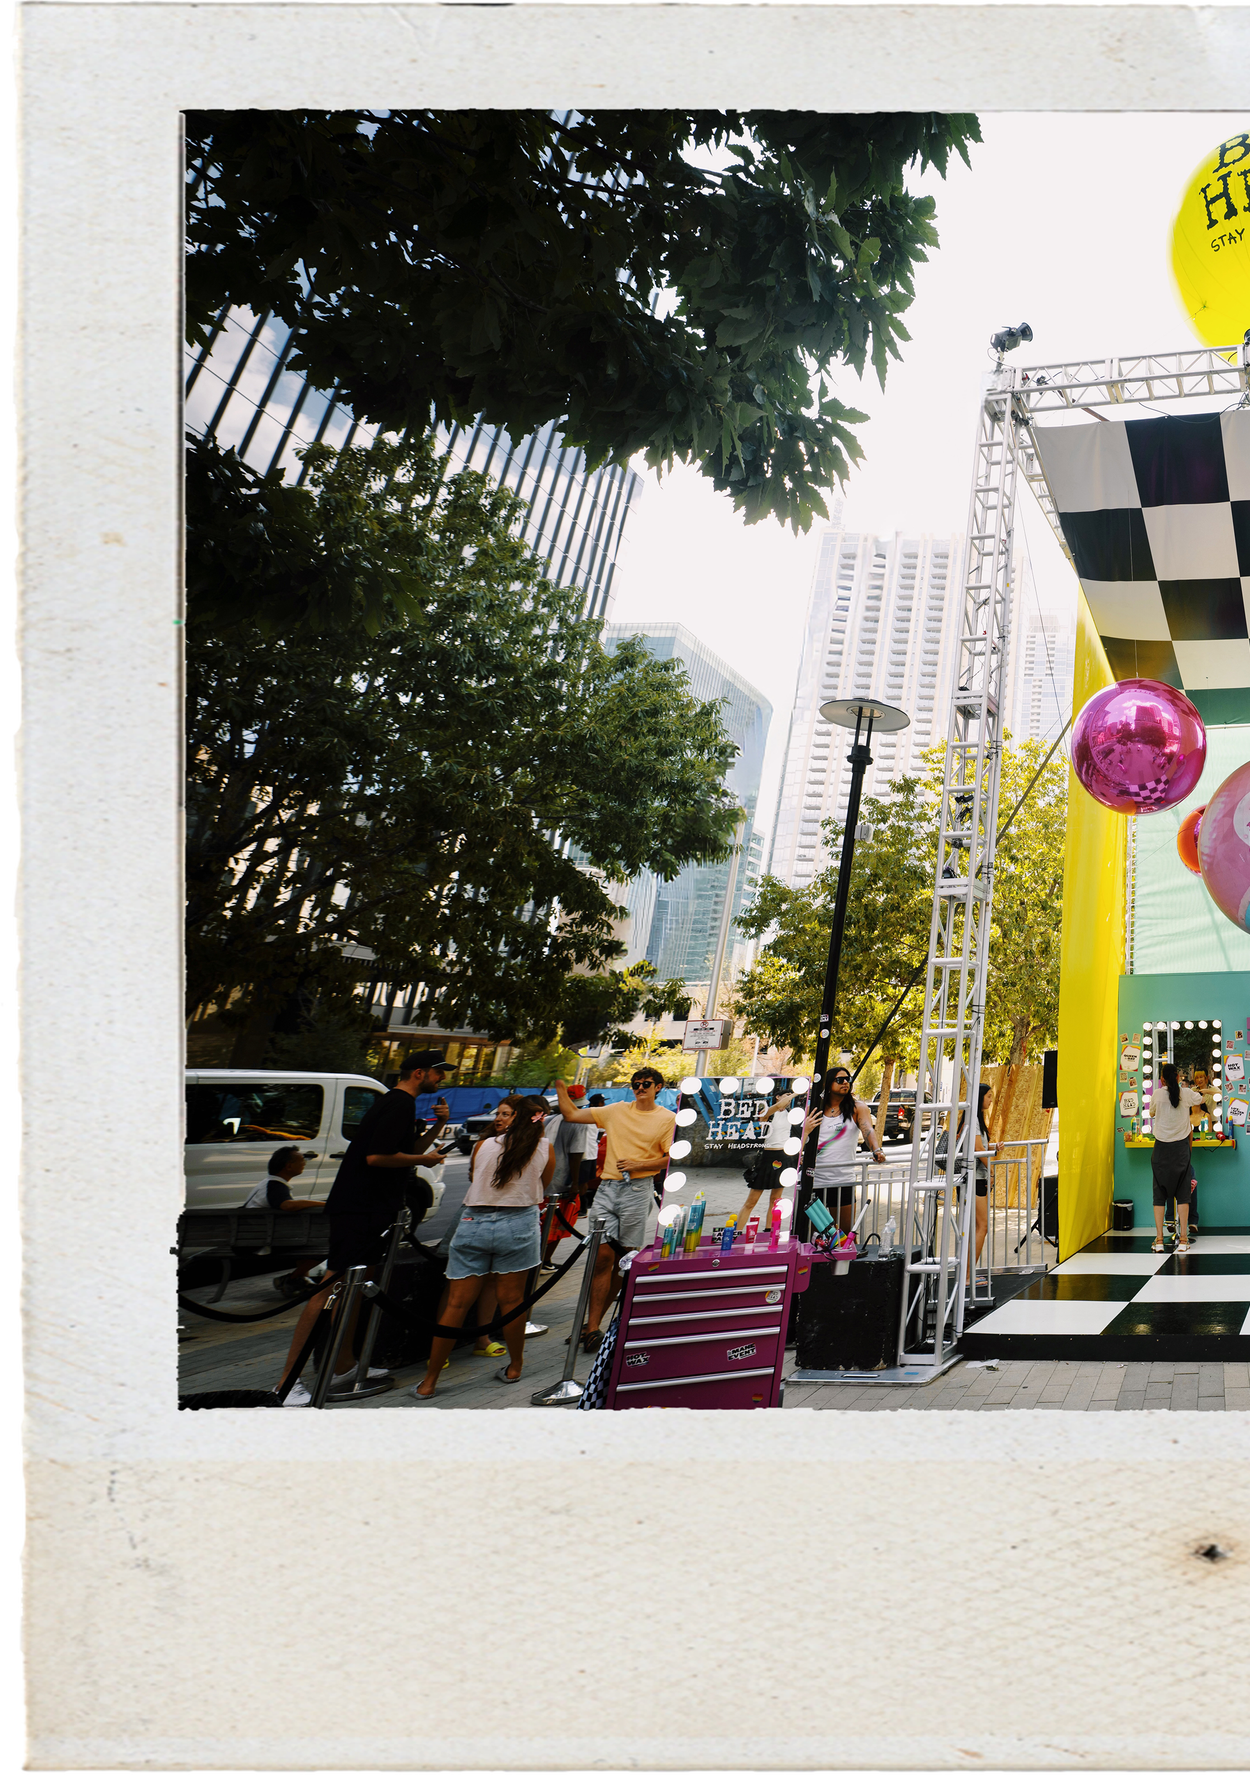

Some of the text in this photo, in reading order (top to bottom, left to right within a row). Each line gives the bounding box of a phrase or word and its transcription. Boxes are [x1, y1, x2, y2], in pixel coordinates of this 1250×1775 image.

[1210, 228, 1245, 252] STAY
[717, 1098, 769, 1119] BED
[706, 1120, 774, 1140] HEAD
[626, 1352, 647, 1361] HOT
[627, 1356, 649, 1366] WAX
[728, 1348, 755, 1360] EVENT
